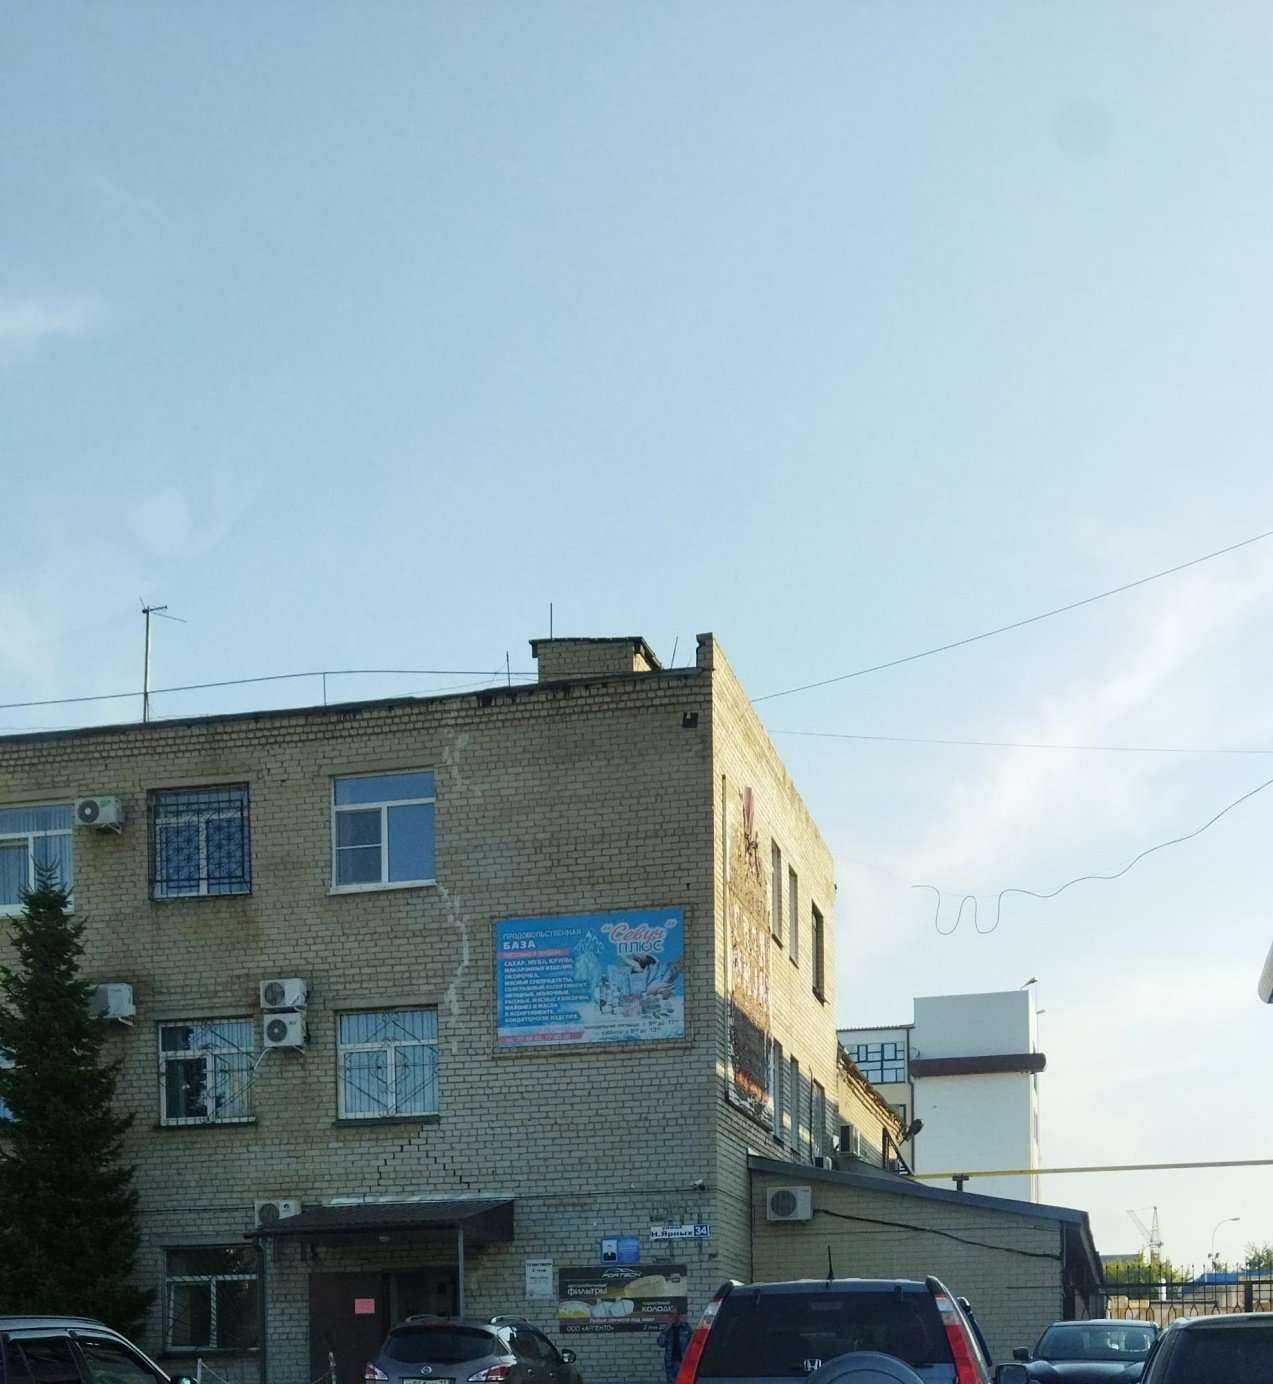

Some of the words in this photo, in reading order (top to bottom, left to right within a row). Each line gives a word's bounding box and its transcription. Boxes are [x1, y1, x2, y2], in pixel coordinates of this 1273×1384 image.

[503, 939, 536, 950] БАЗА
[618, 939, 664, 953] ПЛЮС
[695, 1225, 707, 1236] 34
